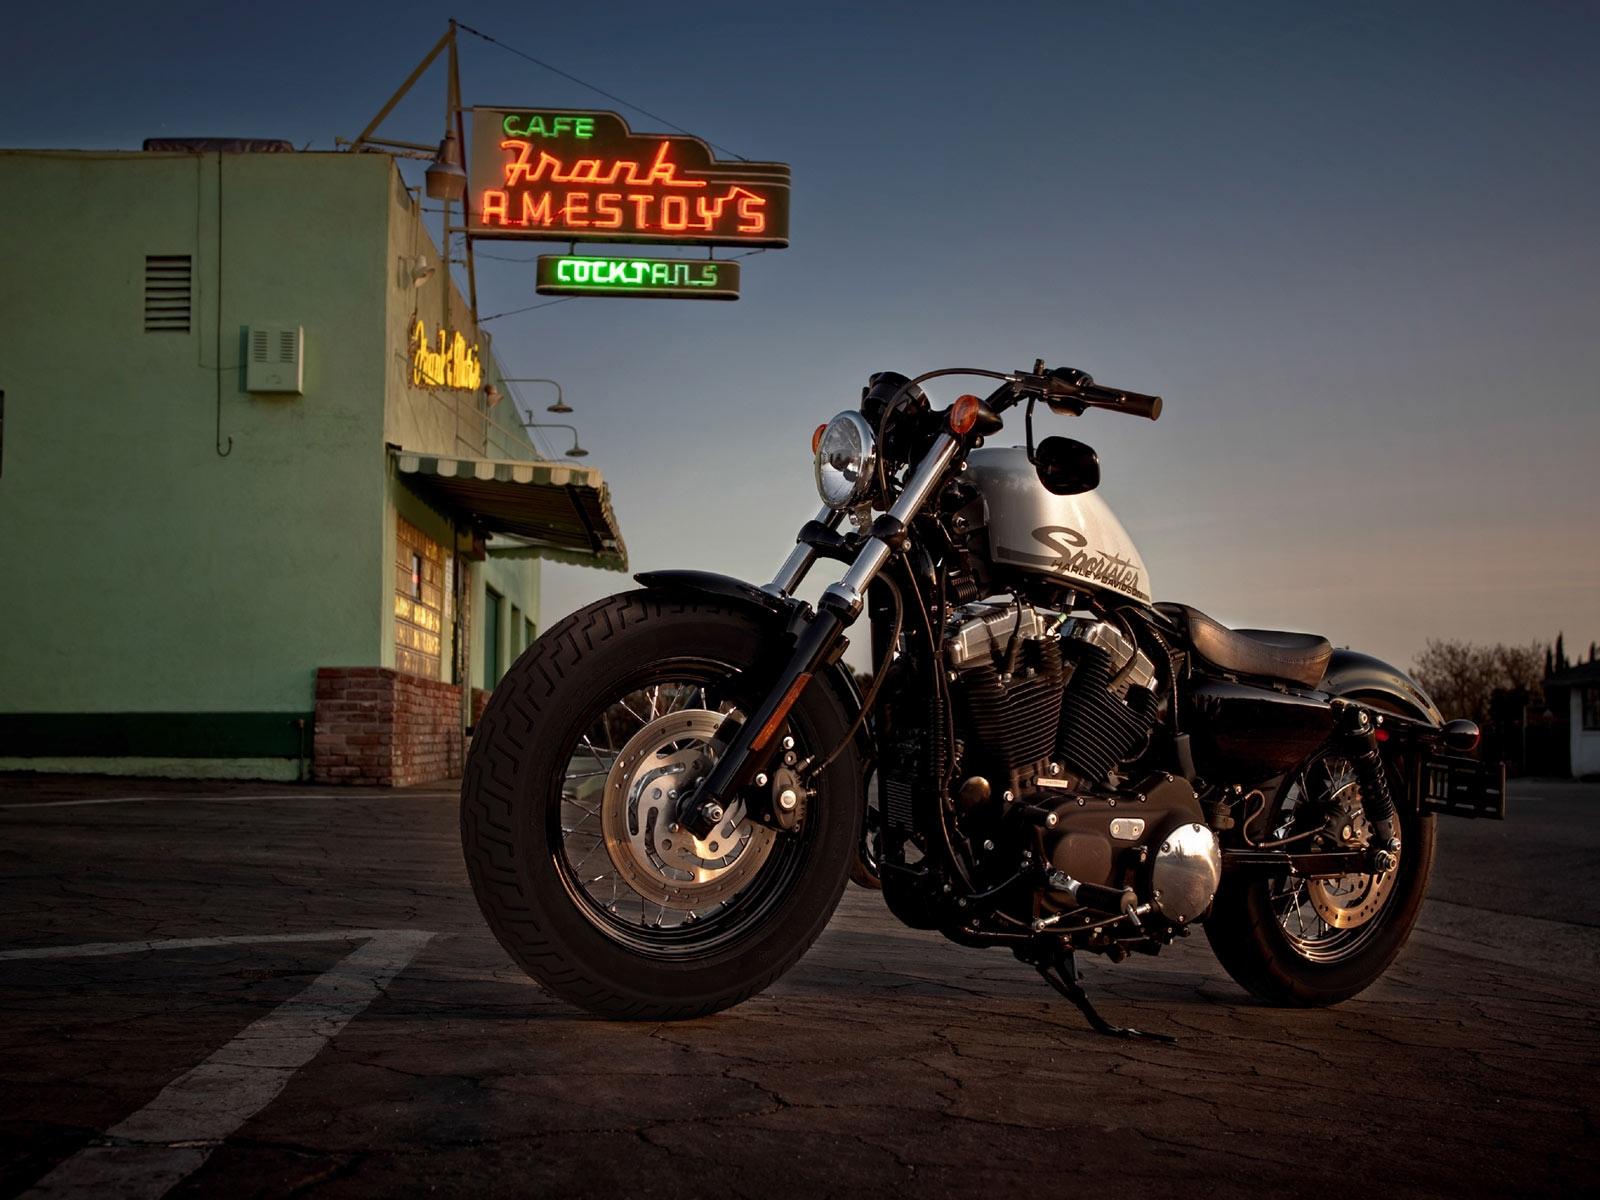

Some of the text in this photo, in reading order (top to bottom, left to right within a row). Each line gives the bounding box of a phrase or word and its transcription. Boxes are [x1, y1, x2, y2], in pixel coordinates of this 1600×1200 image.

[502, 115, 595, 139] CAFE
[500, 139, 708, 187] Frank
[481, 186, 767, 233] AMESTOY'S
[556, 259, 718, 287] COCKTAILS
